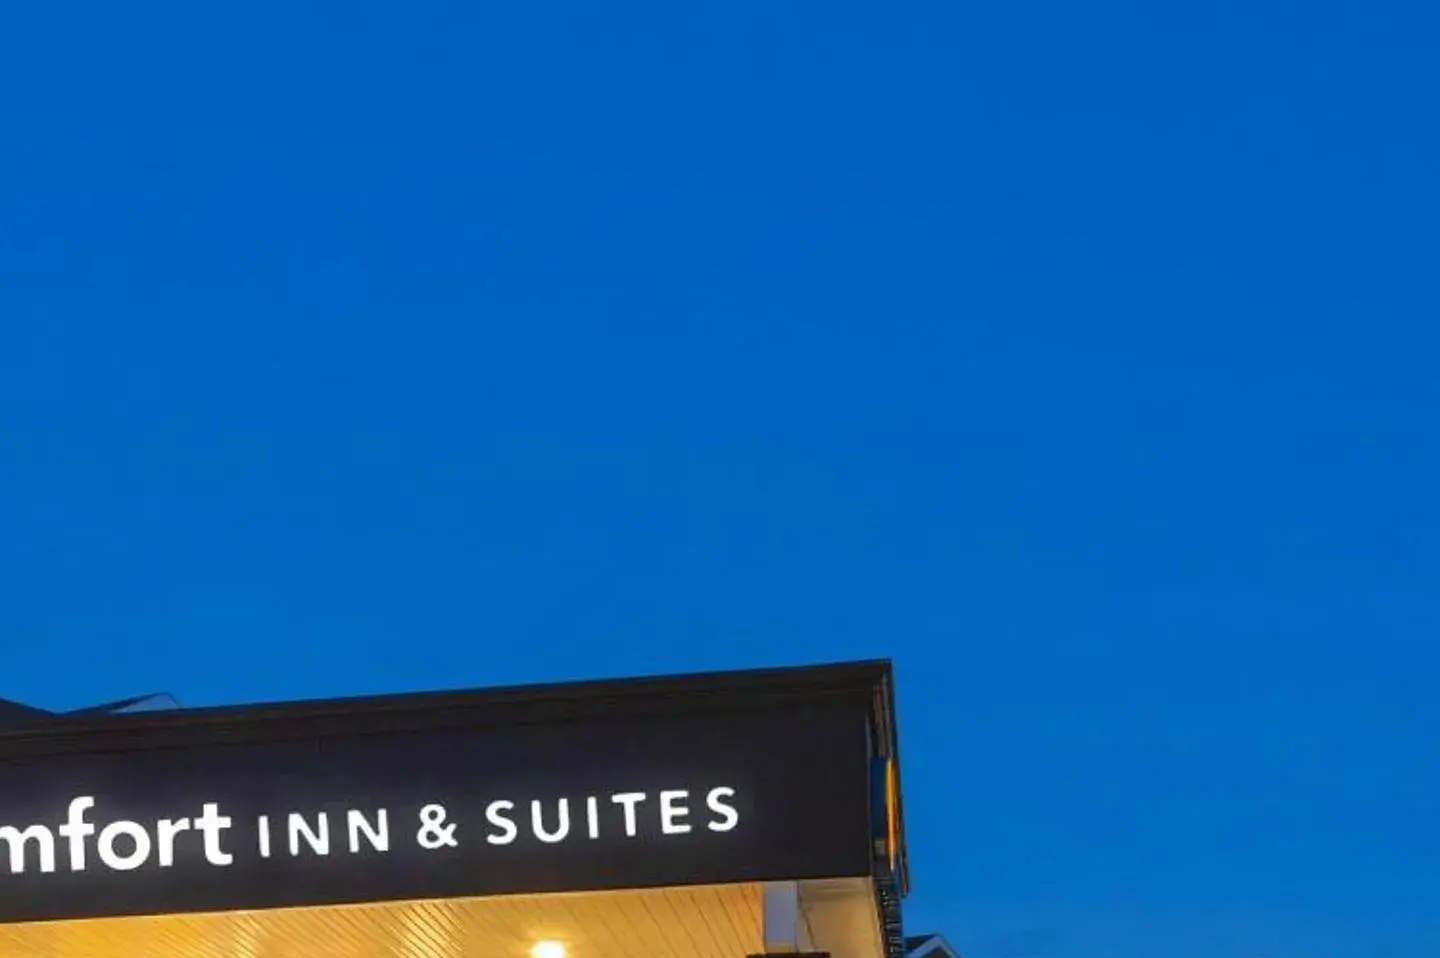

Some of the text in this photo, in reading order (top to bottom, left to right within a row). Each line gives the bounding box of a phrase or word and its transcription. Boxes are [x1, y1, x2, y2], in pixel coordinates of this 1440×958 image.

[257, 807, 390, 859] INN
[415, 803, 459, 850] &
[484, 785, 740, 846] SUITES
